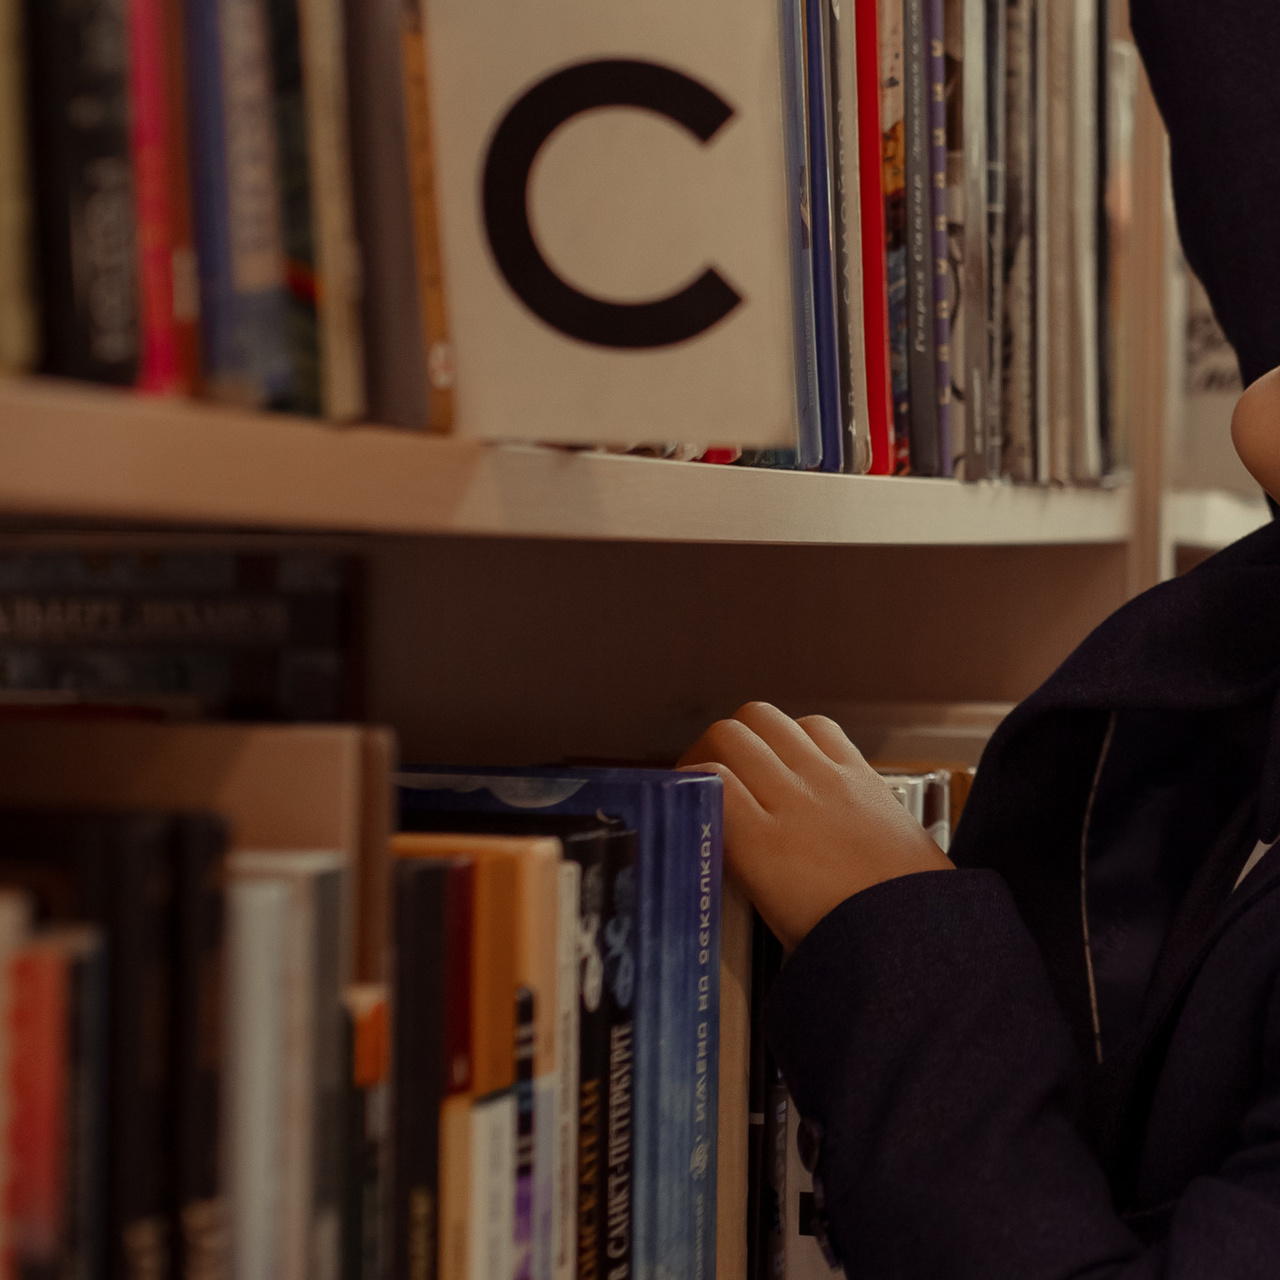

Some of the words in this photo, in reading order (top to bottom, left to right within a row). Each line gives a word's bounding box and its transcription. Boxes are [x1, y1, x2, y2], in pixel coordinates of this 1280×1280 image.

[481, 57, 742, 350] С
[698, 822, 712, 965] ОСКОЛКАХ
[697, 975, 709, 1012] НА
[695, 1021, 708, 1122] ИМЕНА
